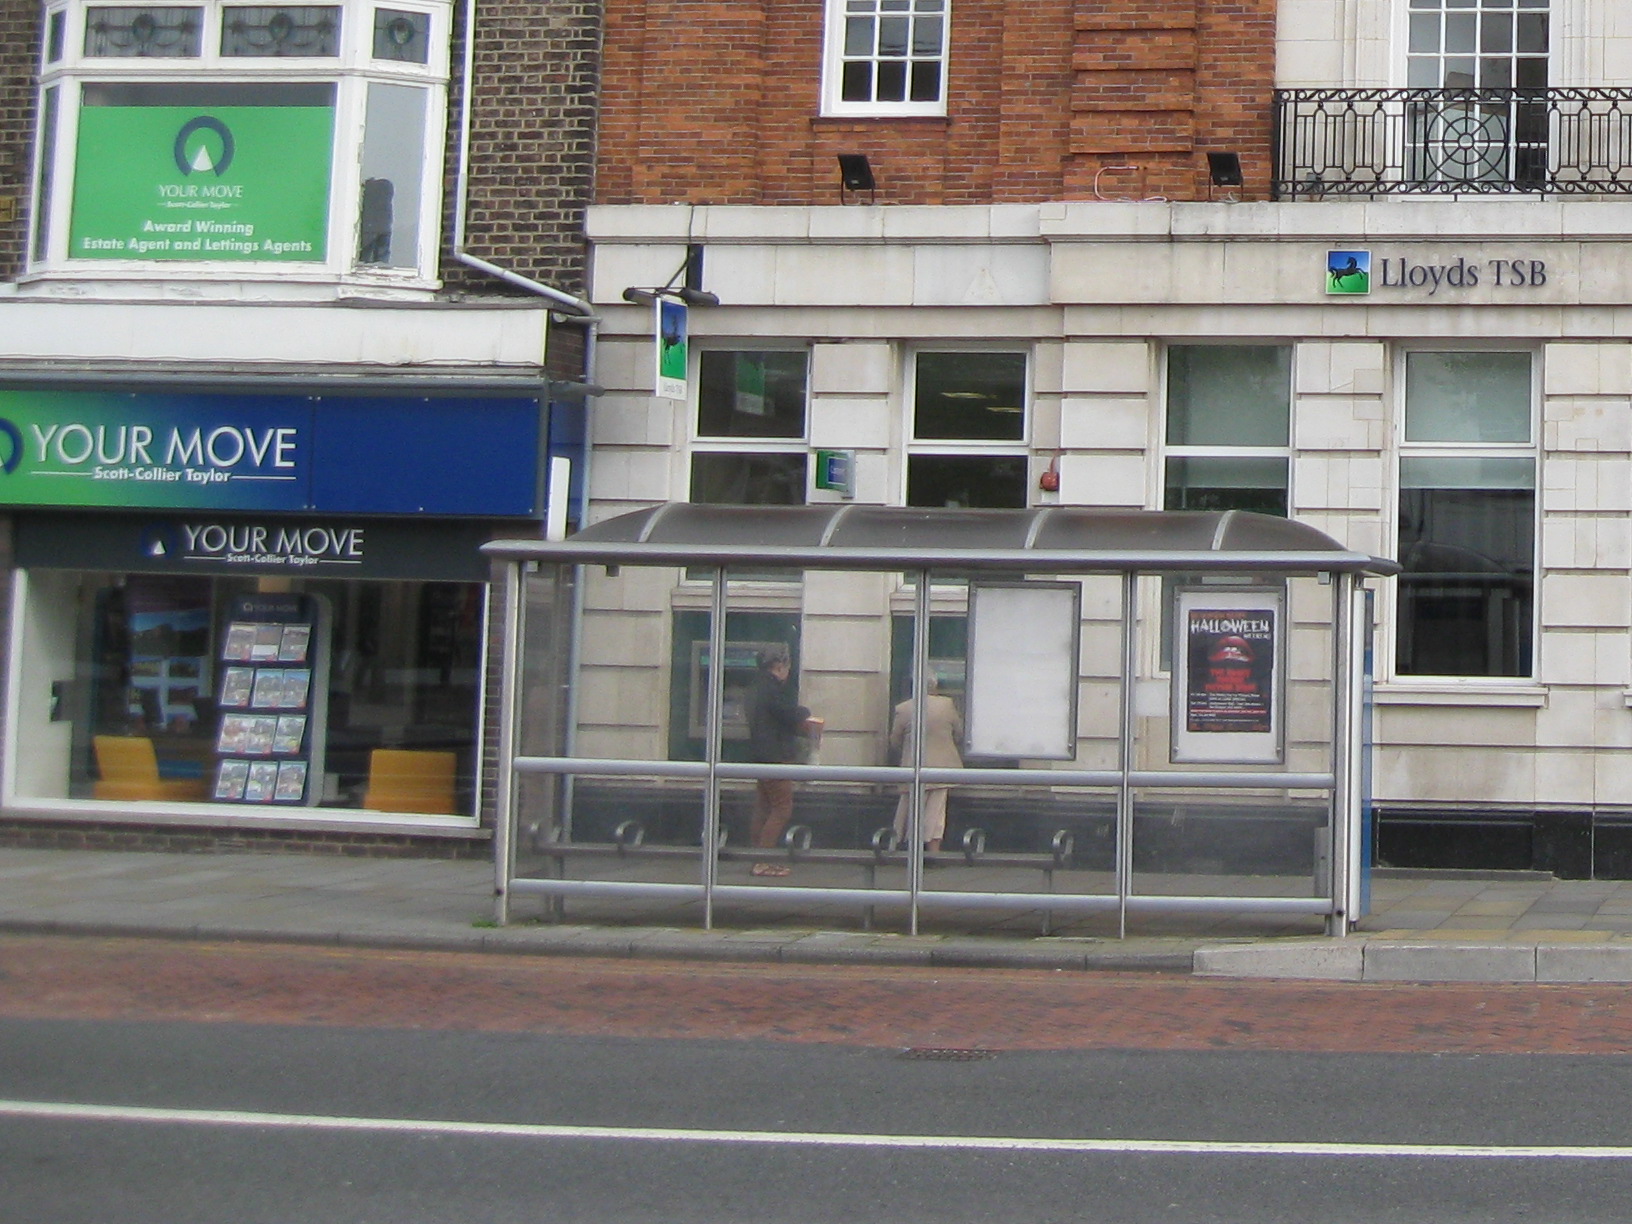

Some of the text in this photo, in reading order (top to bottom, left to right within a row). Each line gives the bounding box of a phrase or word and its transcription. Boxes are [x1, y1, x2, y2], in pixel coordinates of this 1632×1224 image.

[159, 185, 243, 198] YOUR MOVE
[144, 221, 254, 236] Award Winning
[84, 237, 312, 254] Estate Agent and Lettings Agents
[1380, 257, 1547, 295] Lloyds TSB
[32, 424, 297, 467] YOUR MOVE
[93, 466, 231, 484] Scott-Collier Taylor
[184, 525, 365, 556] YOUR MOVE
[227, 553, 319, 566] Scott-Collier Taylor
[1190, 619, 1270, 634] HALLOWEEN
